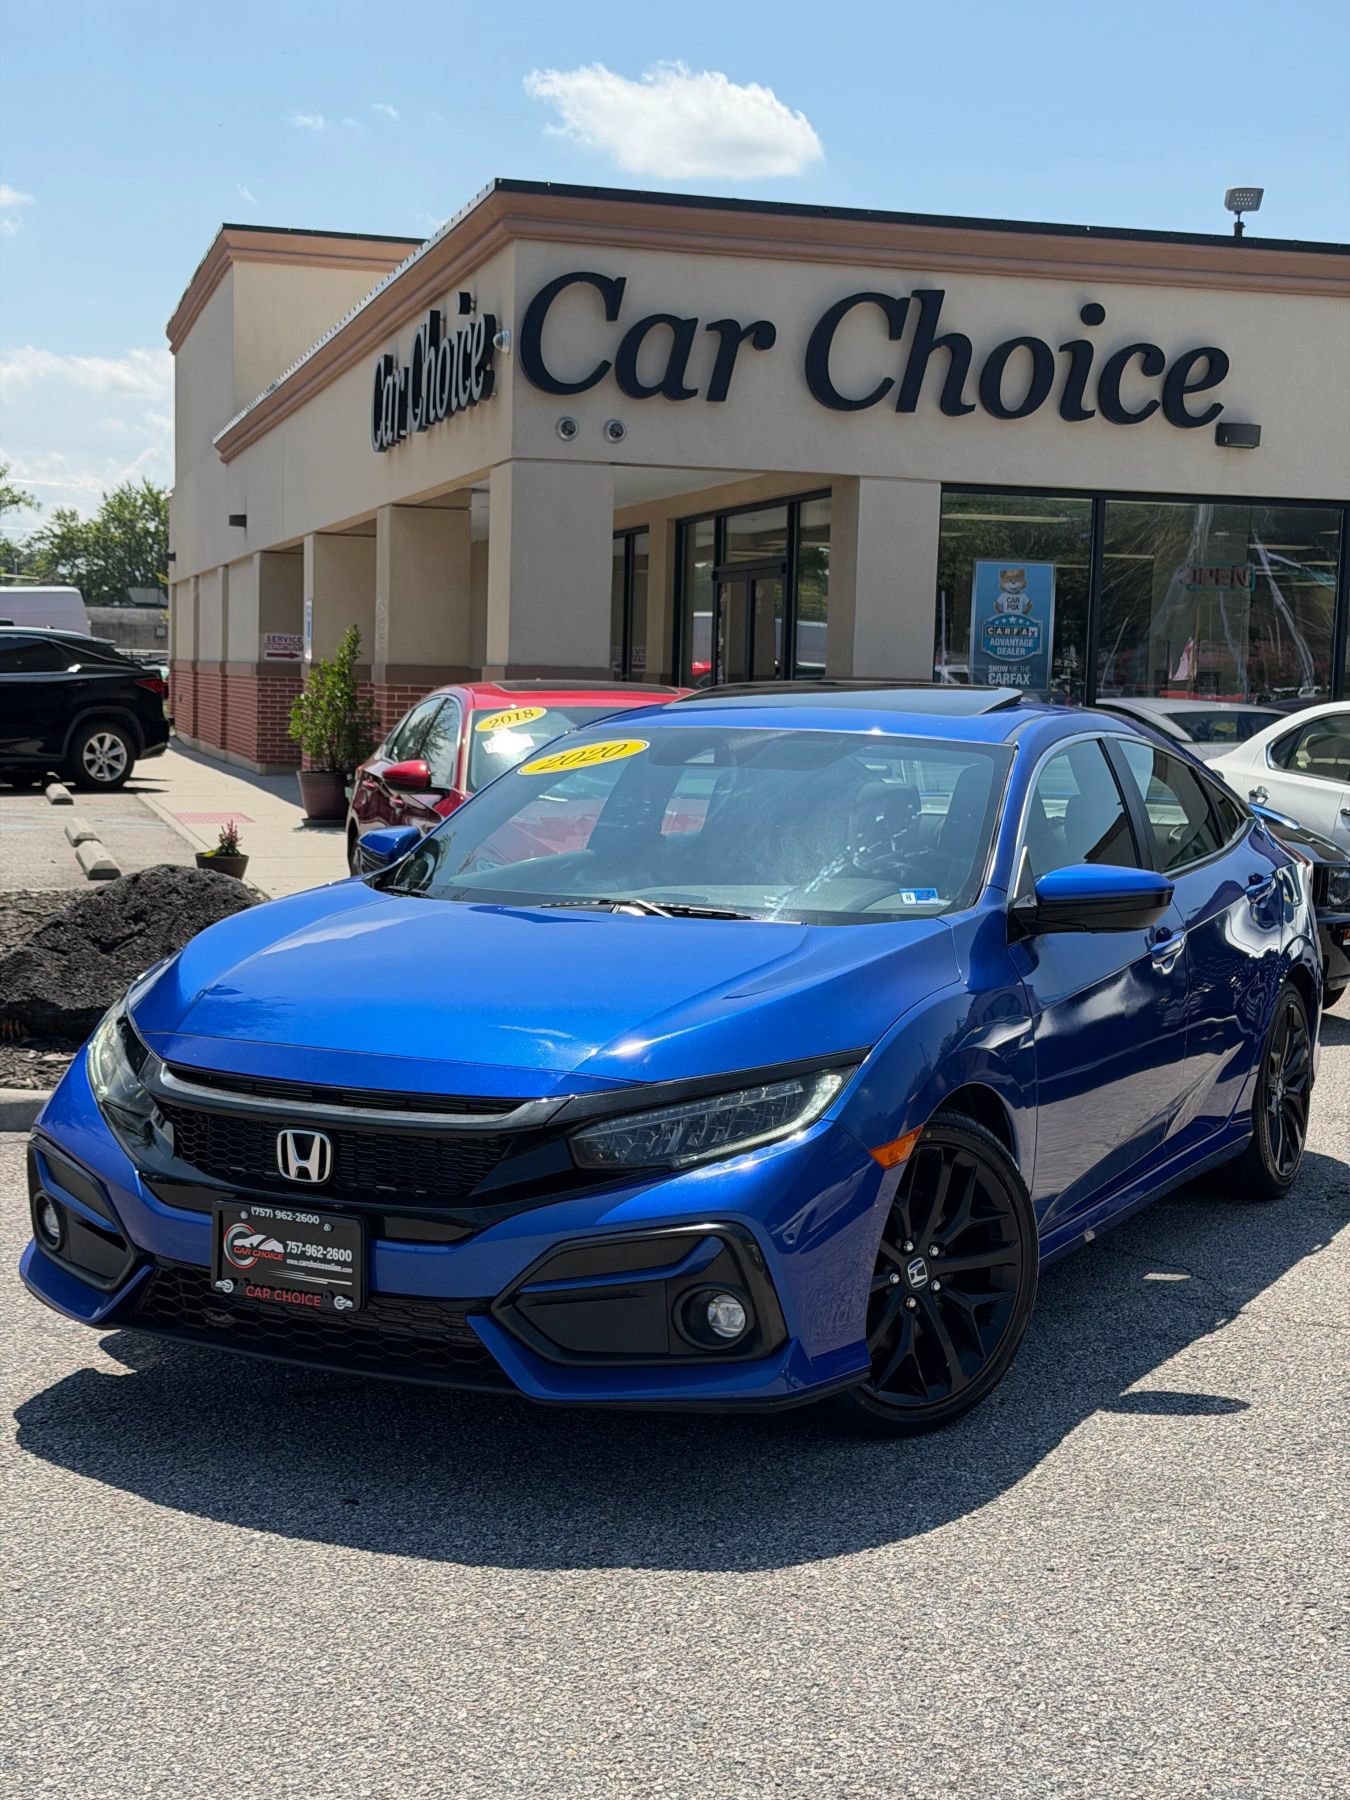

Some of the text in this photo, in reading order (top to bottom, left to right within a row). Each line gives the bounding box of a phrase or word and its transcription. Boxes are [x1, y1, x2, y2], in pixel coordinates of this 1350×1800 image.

[520, 271, 1230, 429] Car Choice
[371, 292, 496, 452] Car Choice
[267, 635, 304, 643] SERVICE
[987, 627, 1037, 637] CARFAX
[989, 639, 1034, 647] ADVANTAGE
[997, 647, 1026, 655] DEALER
[988, 665, 1008, 673] SHOW
[988, 673, 1030, 686] CARFAX
[488, 708, 535, 729] 2018
[536, 743, 629, 771] 2020
[251, 1206, 320, 1224] (757) 962-2600
[233, 1246, 284, 1261] CAR CHOICE
[286, 1240, 353, 1261] 757-962-2600
[246, 1286, 321, 1307] CAR CHOICE
